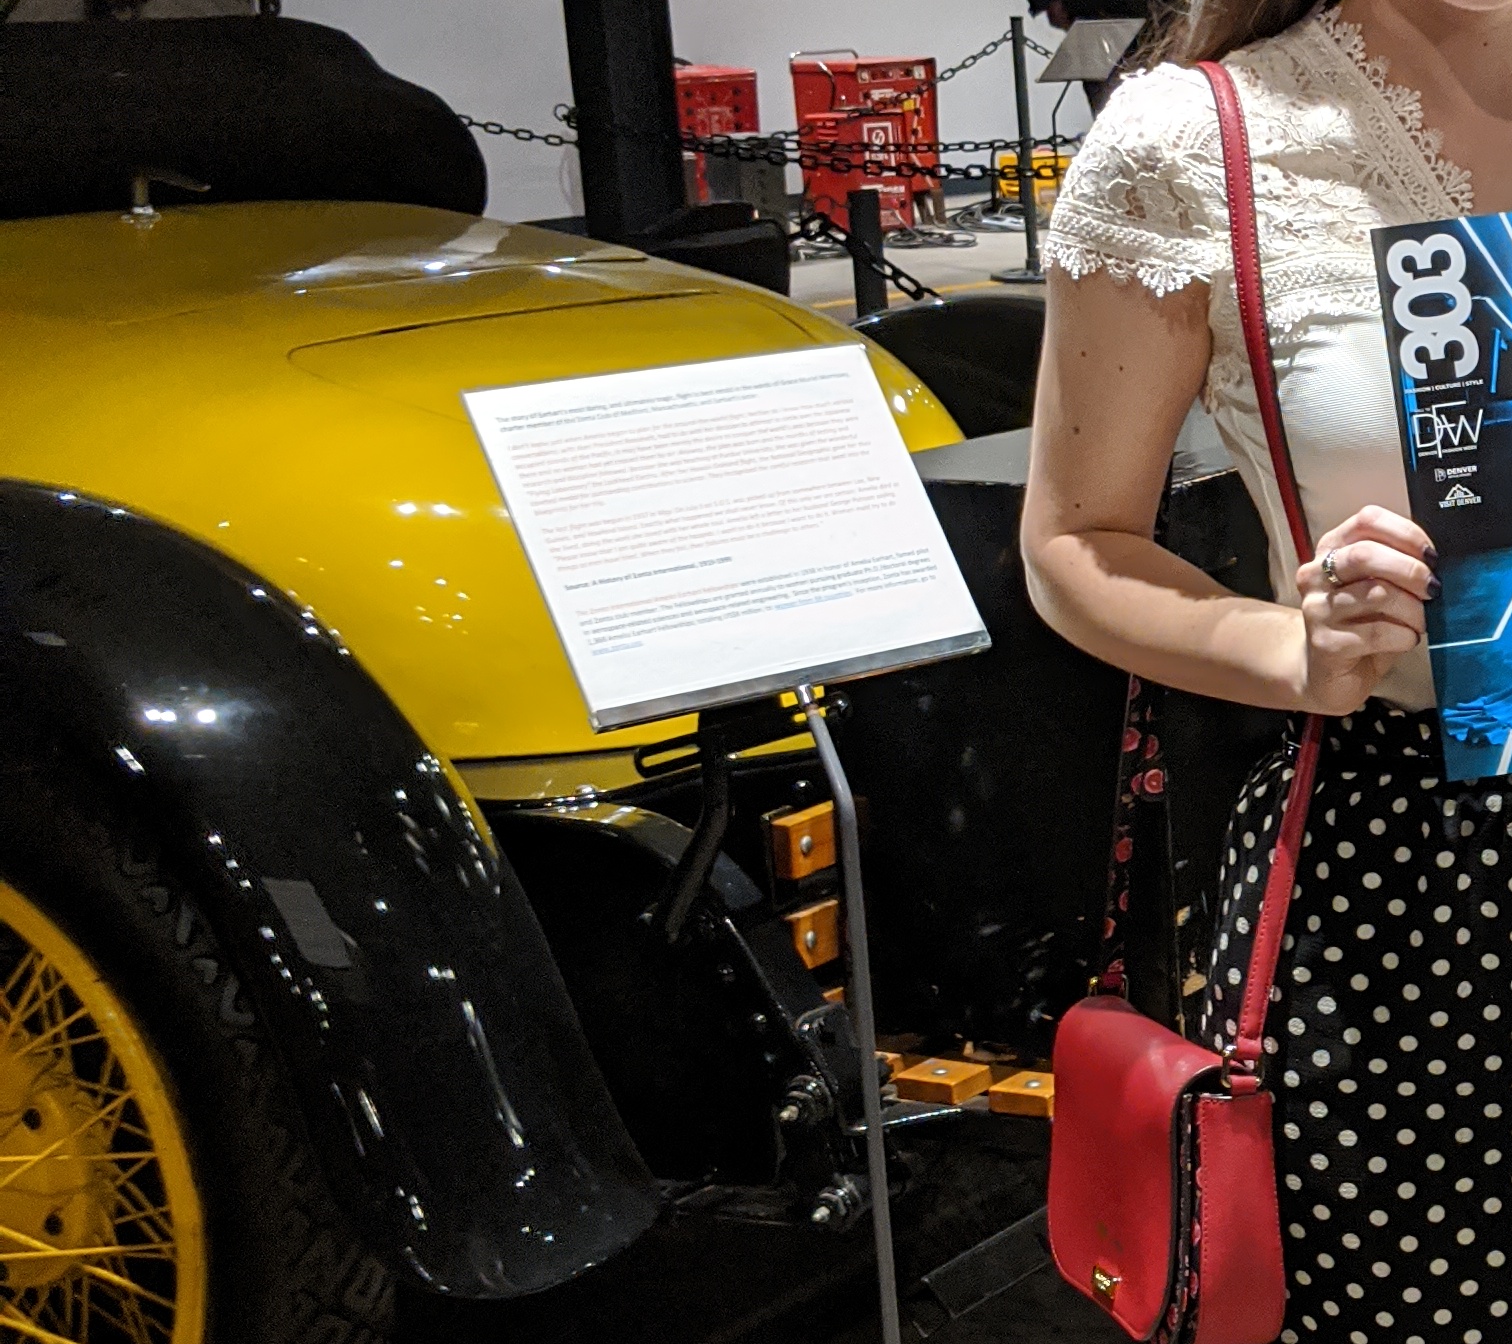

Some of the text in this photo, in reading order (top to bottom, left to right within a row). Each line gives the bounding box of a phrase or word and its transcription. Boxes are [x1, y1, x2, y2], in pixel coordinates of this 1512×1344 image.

[1386, 233, 1480, 380] 303
[1465, 378, 1484, 387] STYLE
[1446, 465, 1478, 476] DENVER
